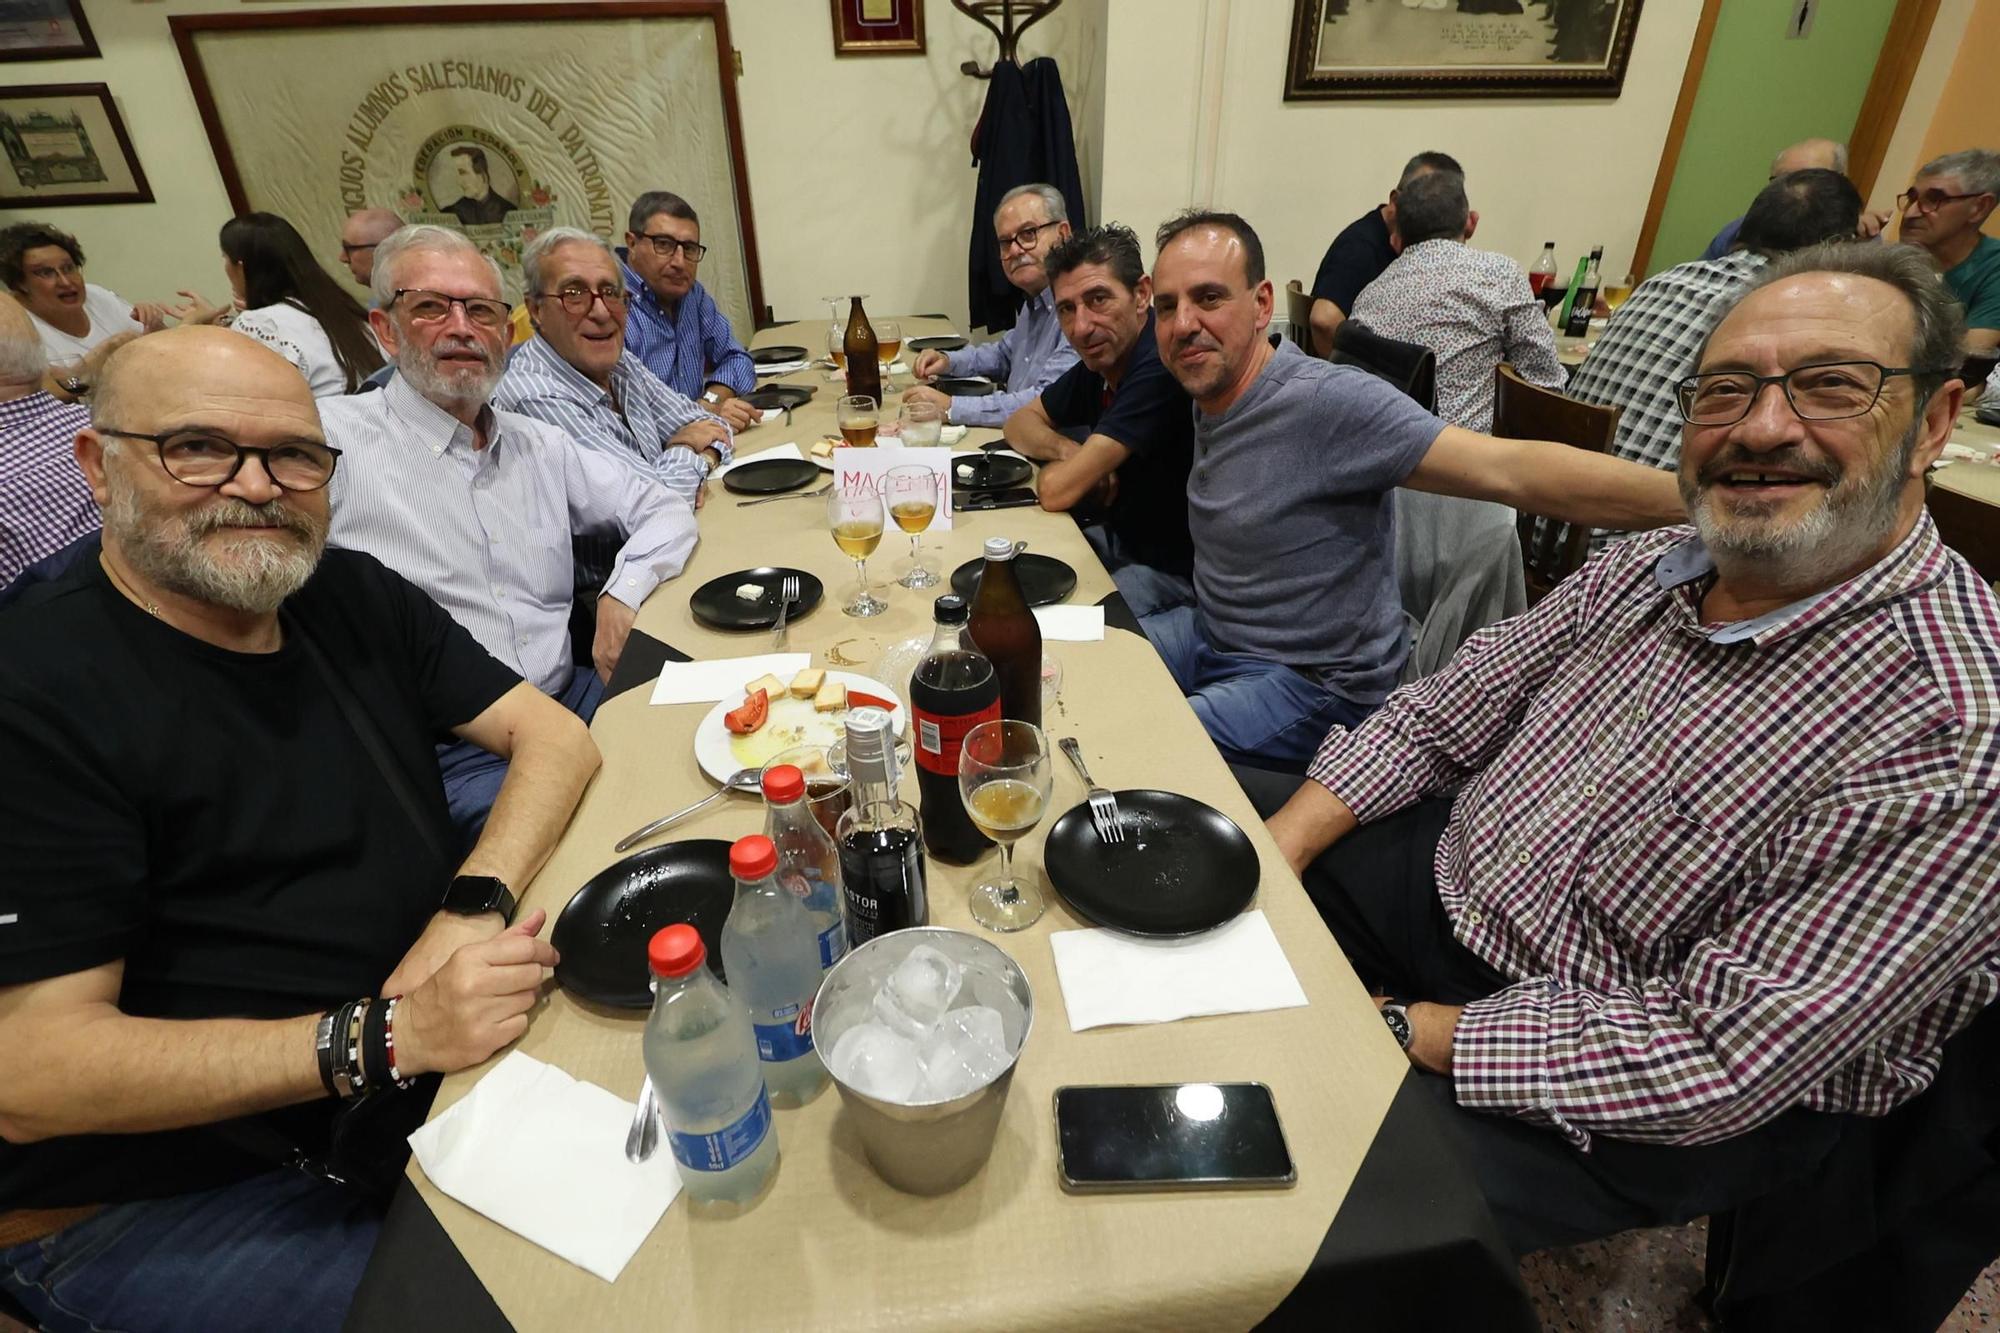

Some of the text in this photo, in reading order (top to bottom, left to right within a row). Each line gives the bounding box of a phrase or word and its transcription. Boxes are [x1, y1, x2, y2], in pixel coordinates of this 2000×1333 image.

[346, 73, 408, 152] ALUMNOS
[406, 60, 525, 103] SALESIANOS
[526, 88, 560, 131] DEL
[558, 122, 614, 237] PATRONATO
